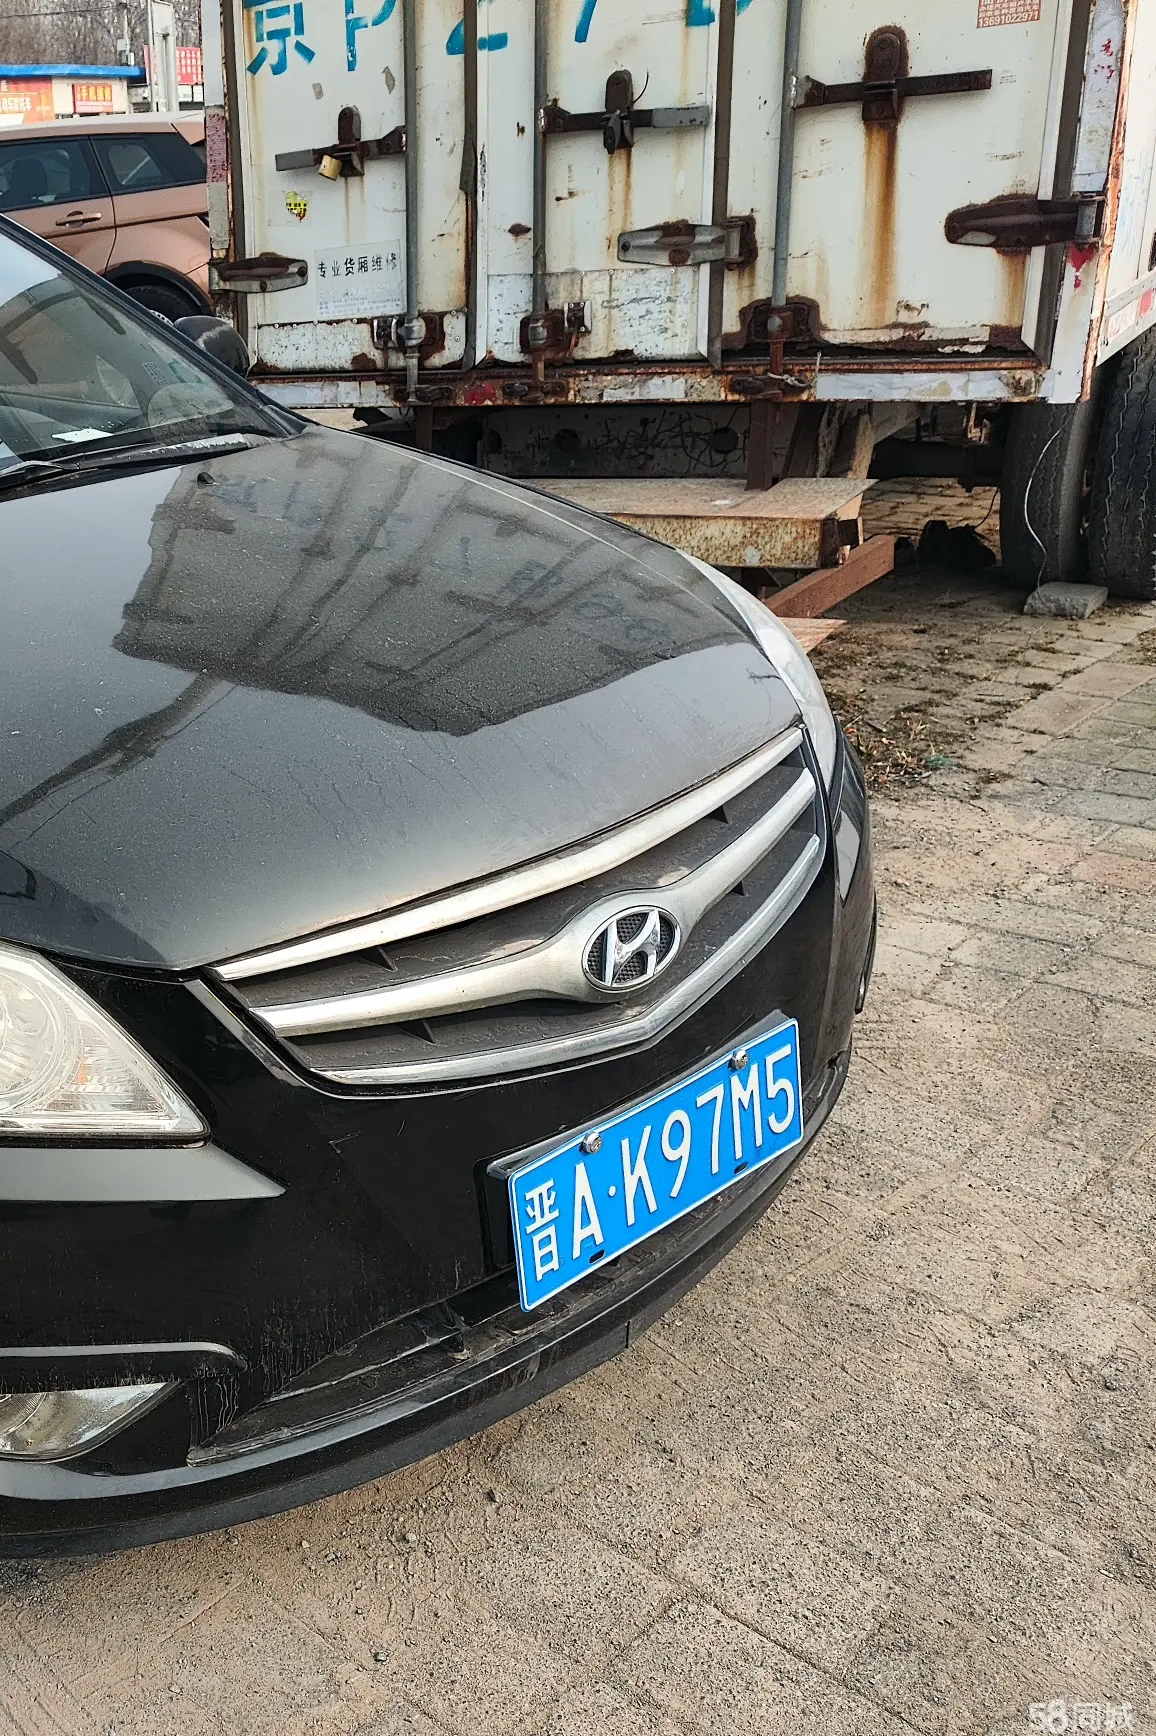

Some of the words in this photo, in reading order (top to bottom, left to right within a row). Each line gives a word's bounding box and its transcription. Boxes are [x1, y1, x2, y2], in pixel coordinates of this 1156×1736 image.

[978, 11, 1039, 27] 13691022971
[317, 252, 397, 278] 专业货厢维修
